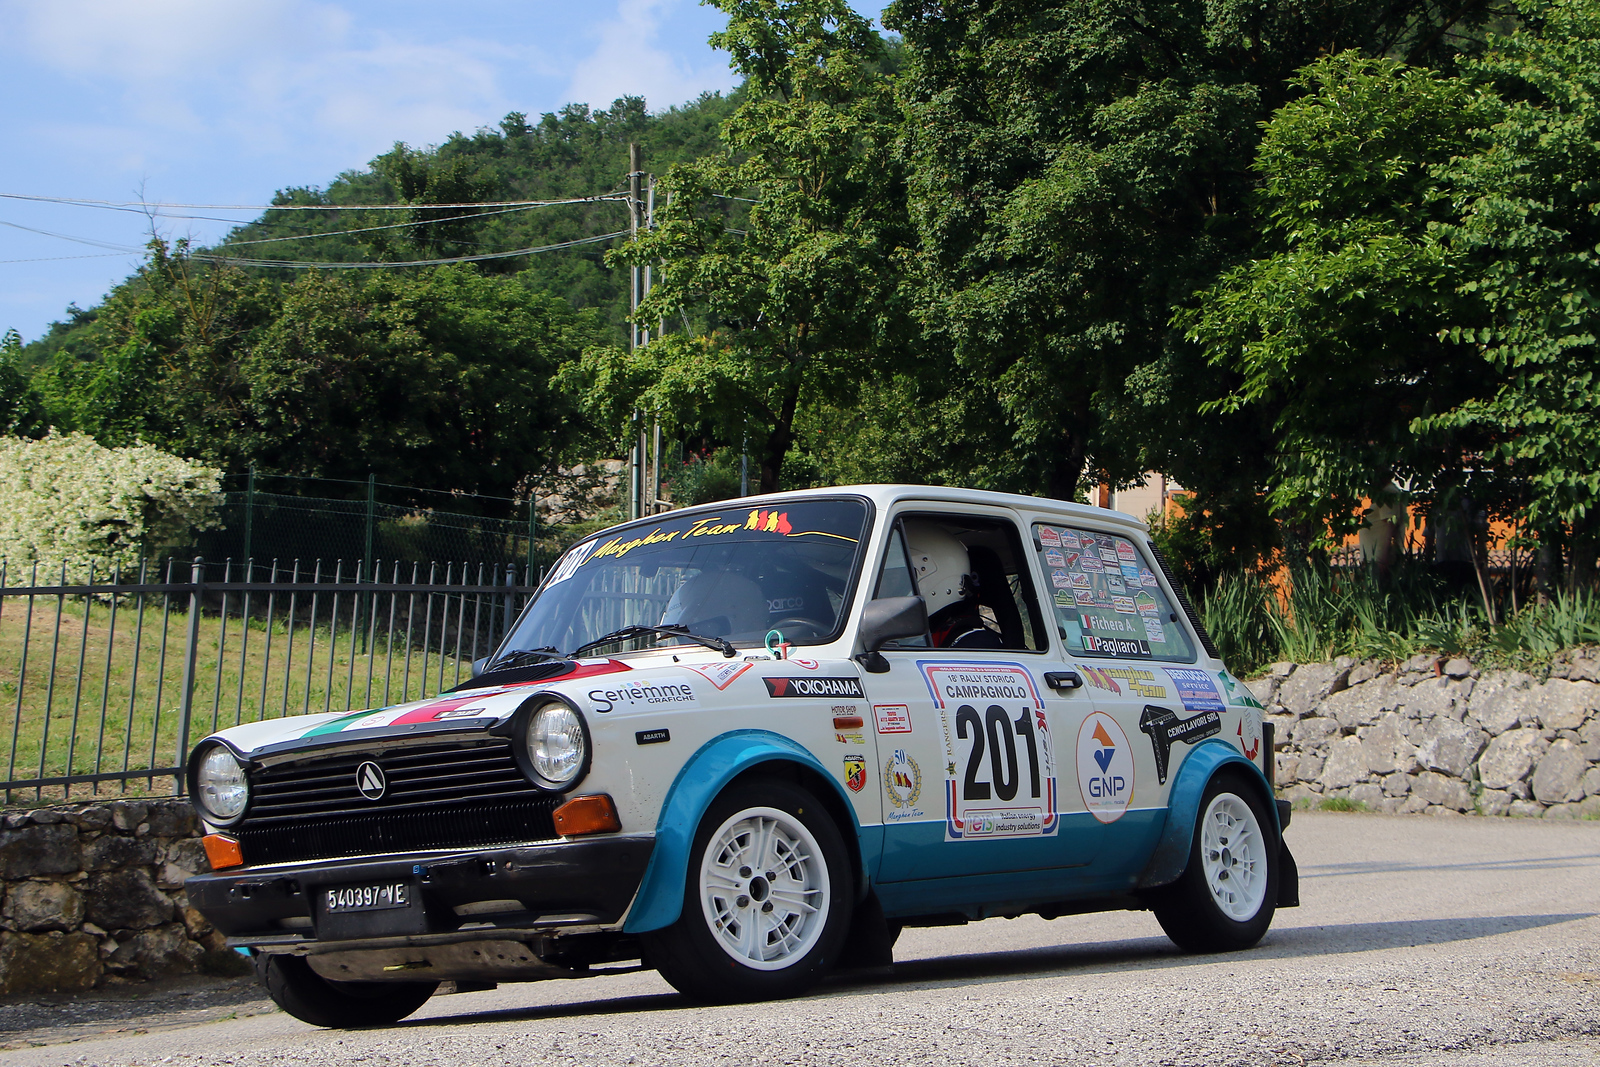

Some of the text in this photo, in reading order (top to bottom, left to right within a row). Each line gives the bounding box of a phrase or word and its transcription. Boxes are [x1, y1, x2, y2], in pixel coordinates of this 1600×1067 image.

[682, 517, 742, 539] Team
[1090, 616, 1136, 632] Fichera A.
[1095, 637, 1150, 657] Pagliaro L.
[960, 674, 981, 683] RALLY
[983, 675, 1015, 683] STORICO
[1164, 669, 1211, 682] BERTOCCO
[788, 679, 862, 698] YOKOHAMA
[946, 685, 1027, 699] CAMPAGNOLO
[1181, 682, 1210, 690] service
[588, 684, 692, 713] Seriemme
[647, 695, 696, 704] GRAFICHE
[940, 710, 953, 756] RANGERS
[1167, 712, 1219, 738] CENCI LAVORI SRL
[643, 732, 666, 741] ABARTH
[894, 749, 906, 765] 50
[956, 704, 1041, 801] 201
[1088, 776, 1125, 798] GNP
[911, 807, 925, 818] Team
[995, 822, 1041, 832] industry solutions
[327, 883, 406, 909] 540397 VE
